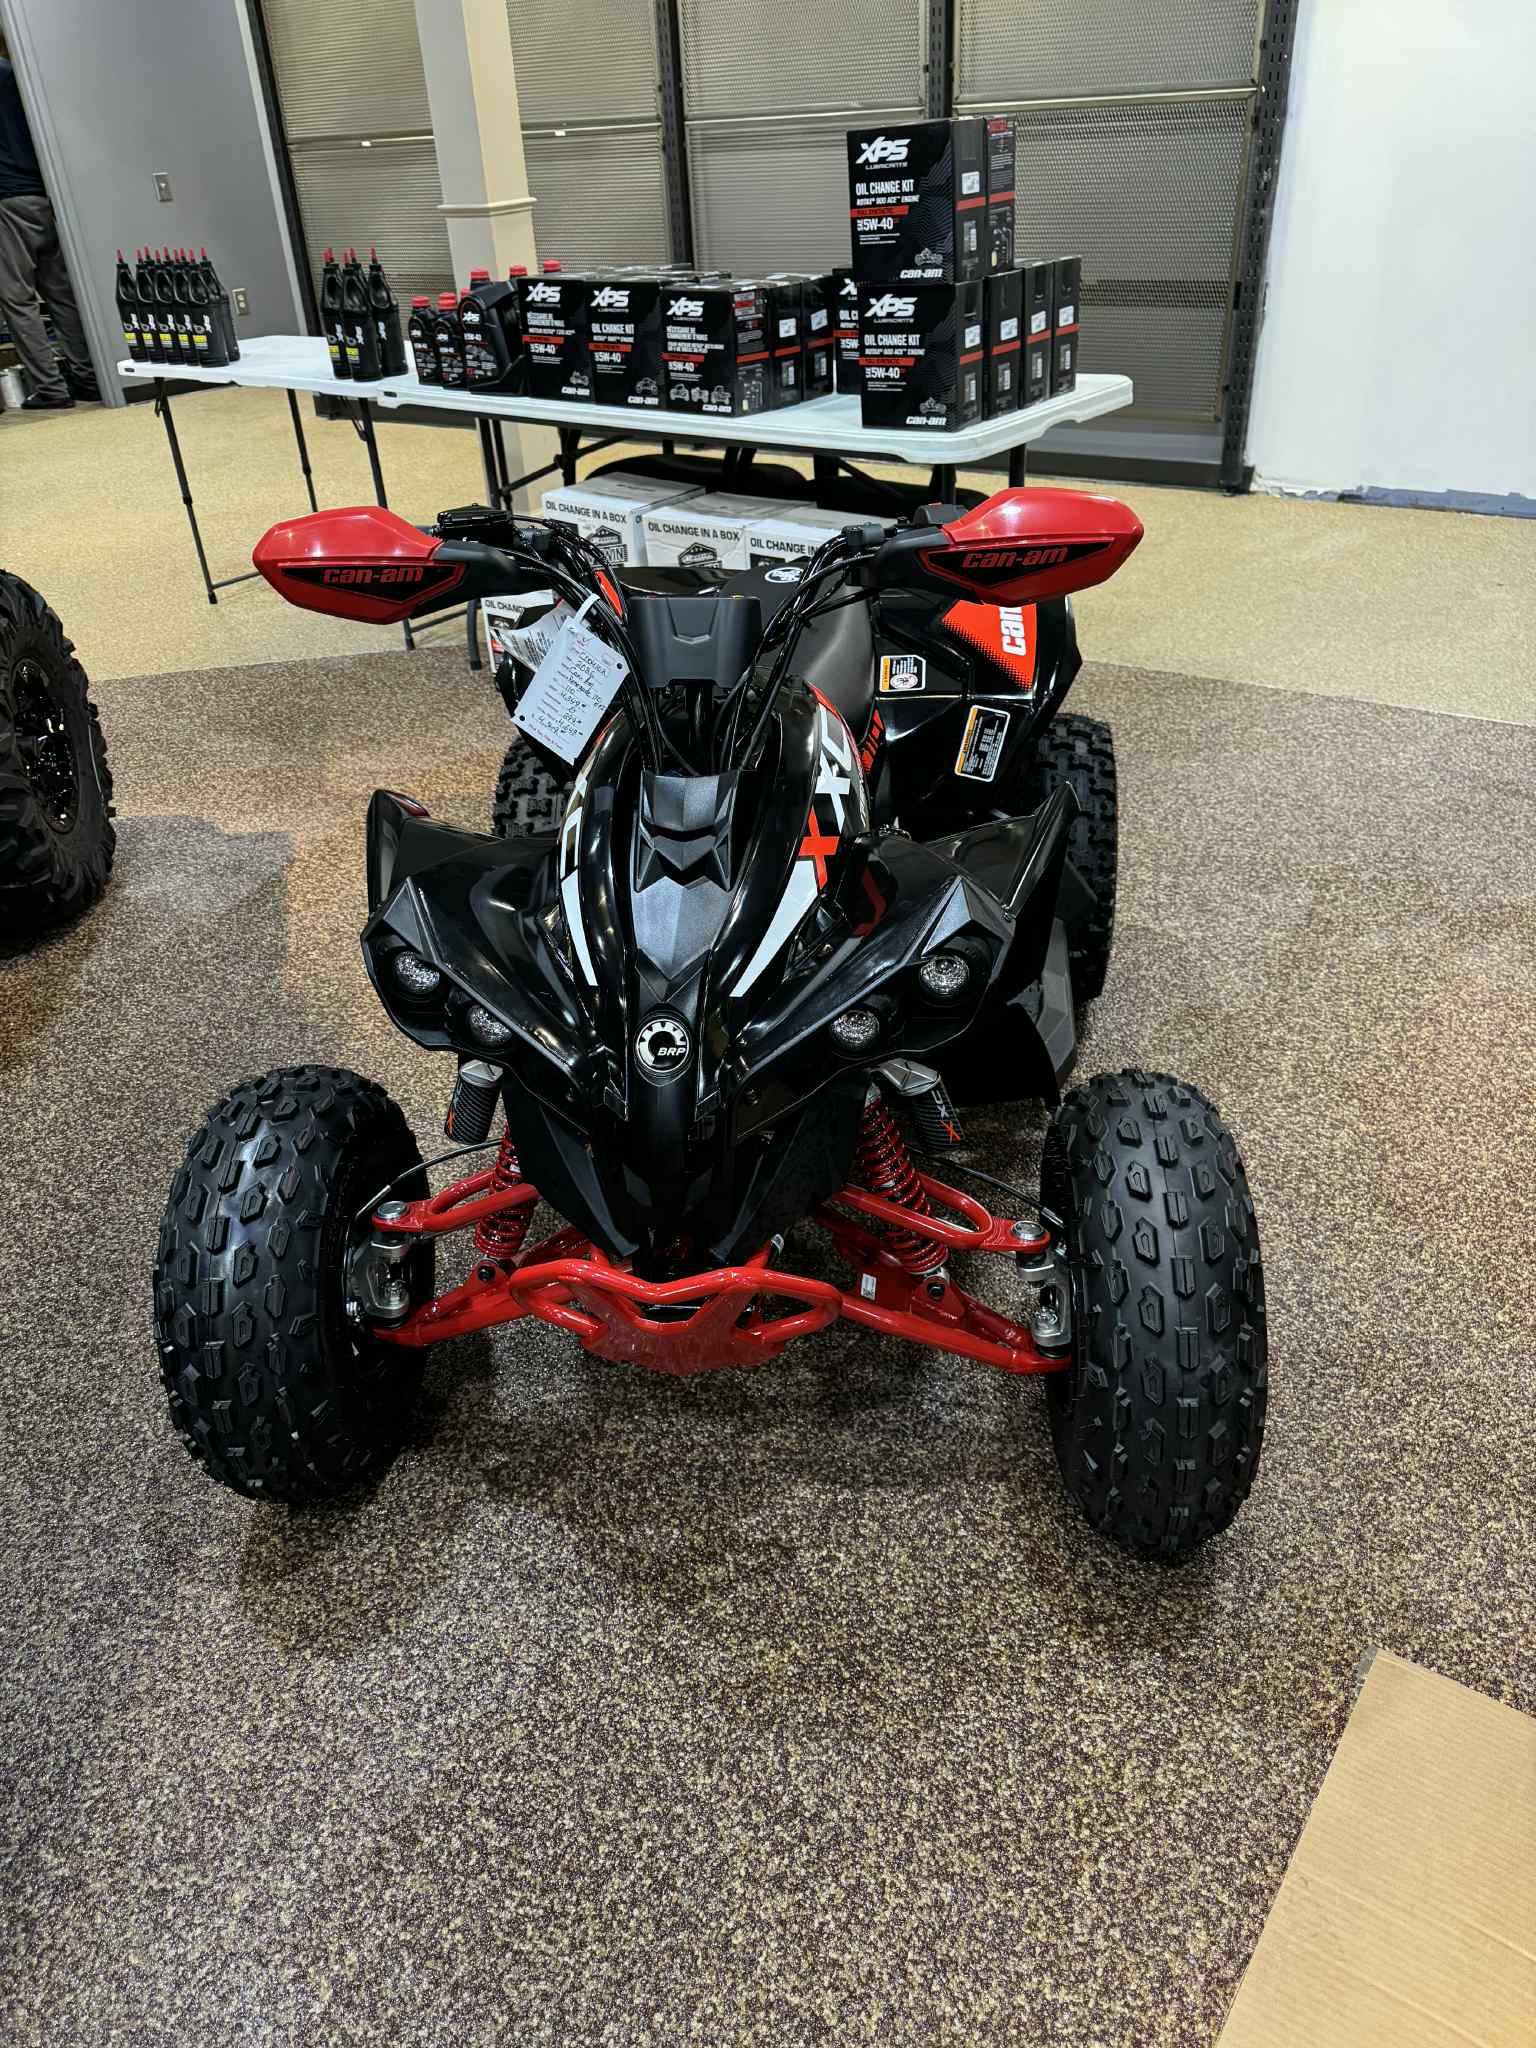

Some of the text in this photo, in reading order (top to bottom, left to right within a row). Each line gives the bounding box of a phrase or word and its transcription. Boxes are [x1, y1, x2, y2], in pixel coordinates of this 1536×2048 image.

[855, 136, 911, 164] XPS
[856, 179, 914, 195] OIL CHANGE KIT
[864, 217, 893, 231] 5W-40
[900, 269, 943, 279] can-am
[526, 282, 562, 302] XPS
[840, 278, 857, 295] X
[590, 287, 630, 307] XPS
[666, 297, 704, 316] XPS
[864, 294, 918, 317] XPS
[591, 323, 634, 334] OIL CHANGE KIT
[864, 334, 920, 345] OIL CHANGE KIT
[871, 367, 900, 378] 5W-40
[906, 416, 946, 425] can-am
[546, 501, 557, 511] OIL
[559, 503, 590, 517] CHANGE
[592, 510, 600, 519] IN
[602, 512, 608, 520] A
[610, 512, 627, 523] BOX
[648, 522, 740, 541] OIL CHANGE IN A BOX
[751, 538, 764, 548] OIL
[766, 540, 806, 554] CHANGE
[962, 547, 1068, 569] can-am
[323, 567, 424, 584] can-am
[485, 599, 497, 609] OIL
[657, 1047, 686, 1056] BRP
